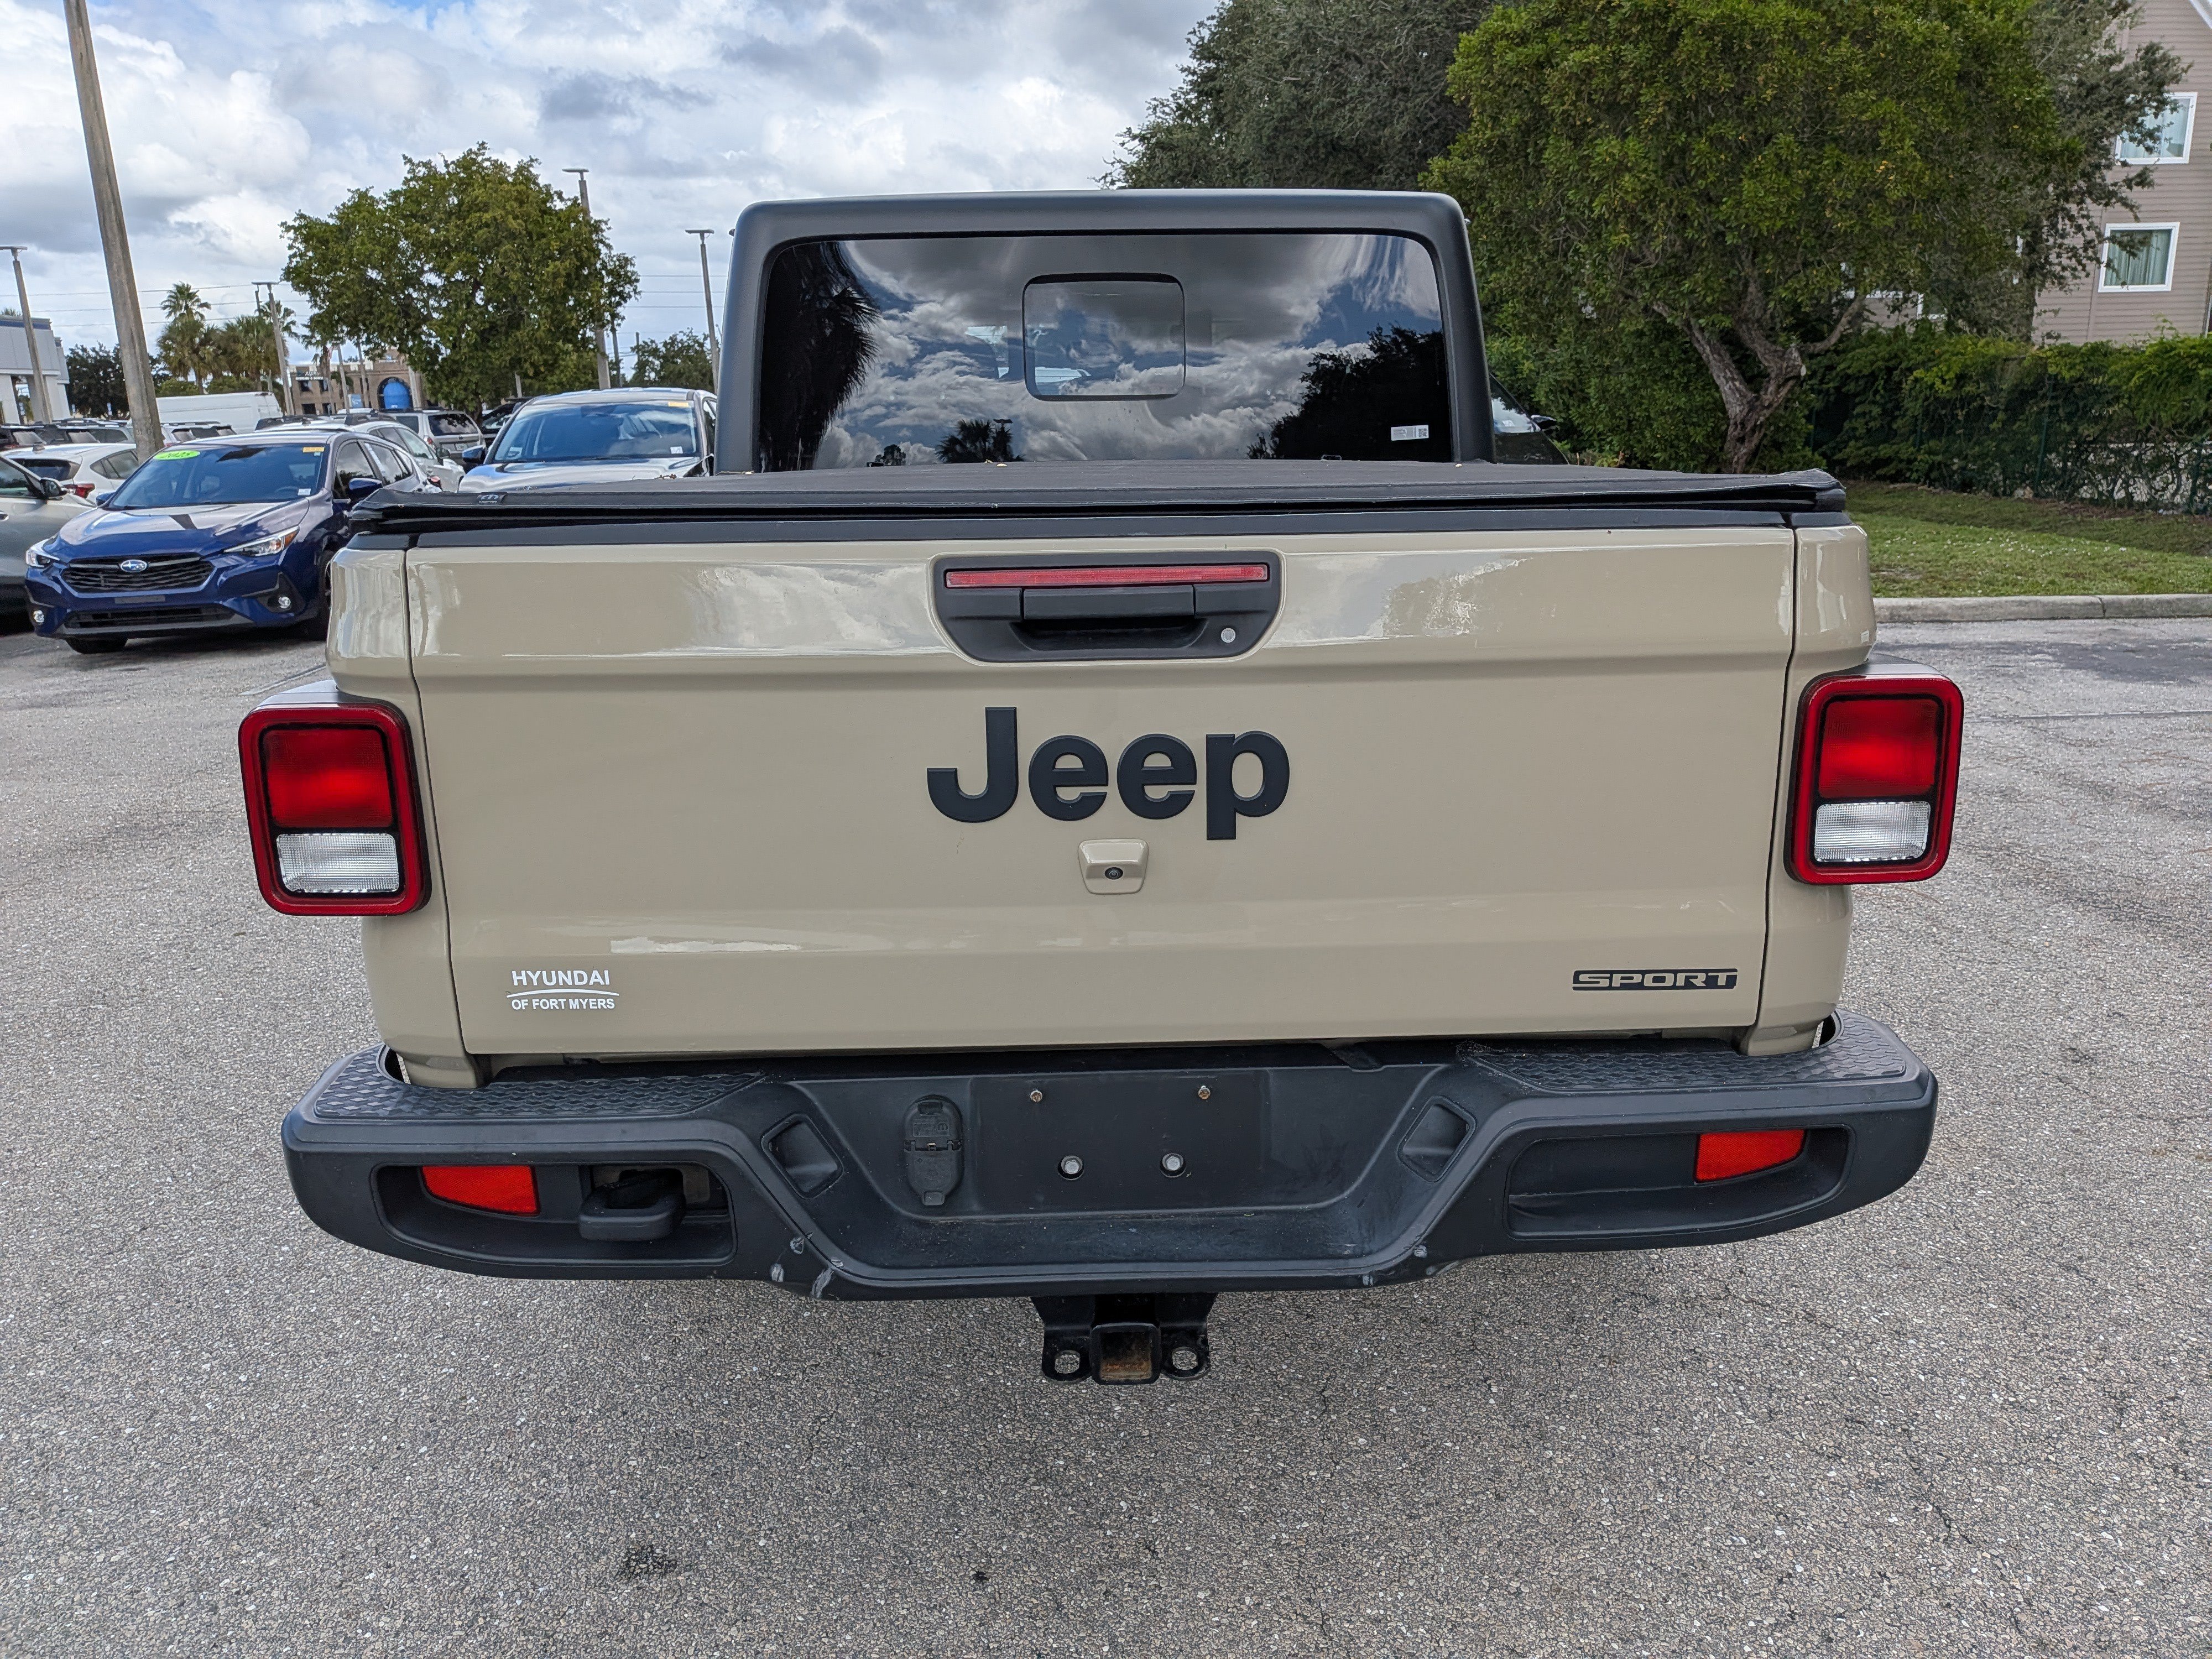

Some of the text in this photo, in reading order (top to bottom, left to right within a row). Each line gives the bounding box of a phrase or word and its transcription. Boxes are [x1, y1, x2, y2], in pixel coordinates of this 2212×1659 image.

[927, 707, 1290, 840] Jeep
[512, 971, 609, 985] HYUNDAI
[1573, 971, 1738, 988] SPORT
[512, 998, 615, 1010] OF FORT MYERS
